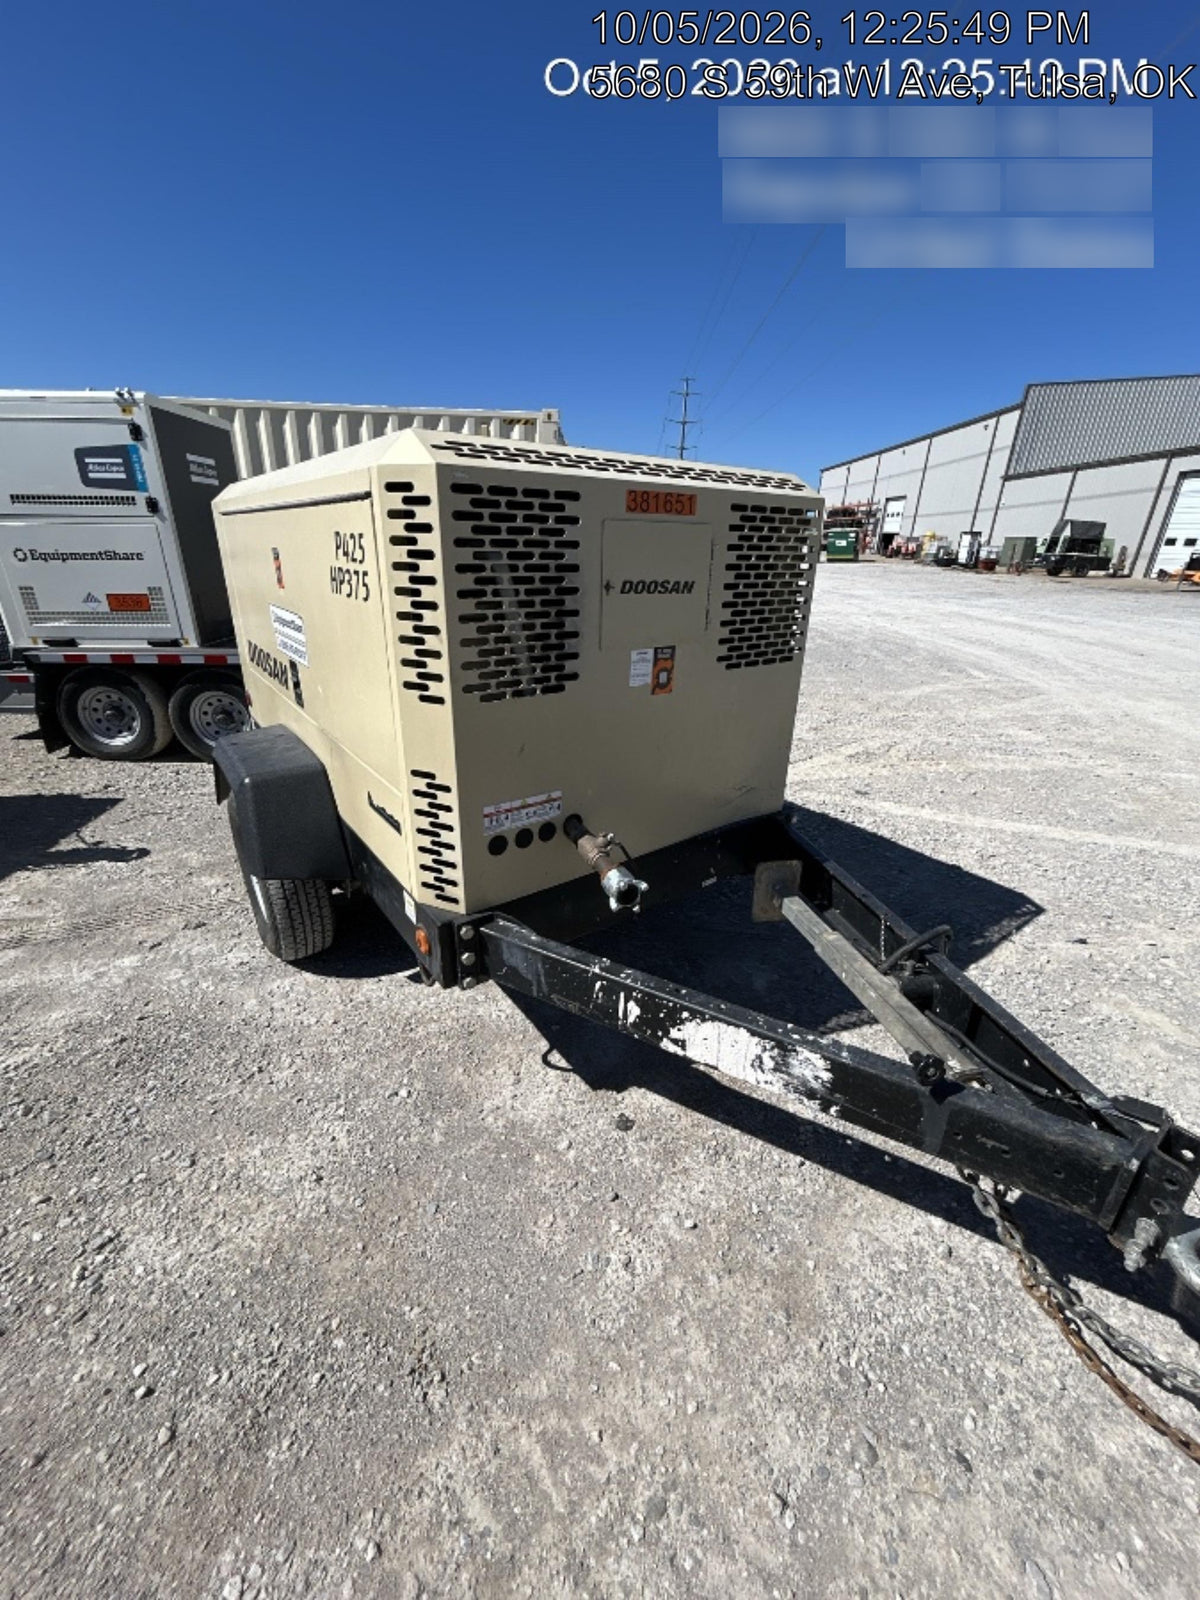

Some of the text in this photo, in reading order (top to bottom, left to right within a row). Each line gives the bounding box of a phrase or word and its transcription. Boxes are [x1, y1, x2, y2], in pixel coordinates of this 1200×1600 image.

[626, 489, 697, 516] 381651
[28, 548, 145, 564] EquipmentShare
[334, 530, 365, 565] P425
[329, 565, 371, 602] HP375
[619, 579, 696, 595] DOOSAN
